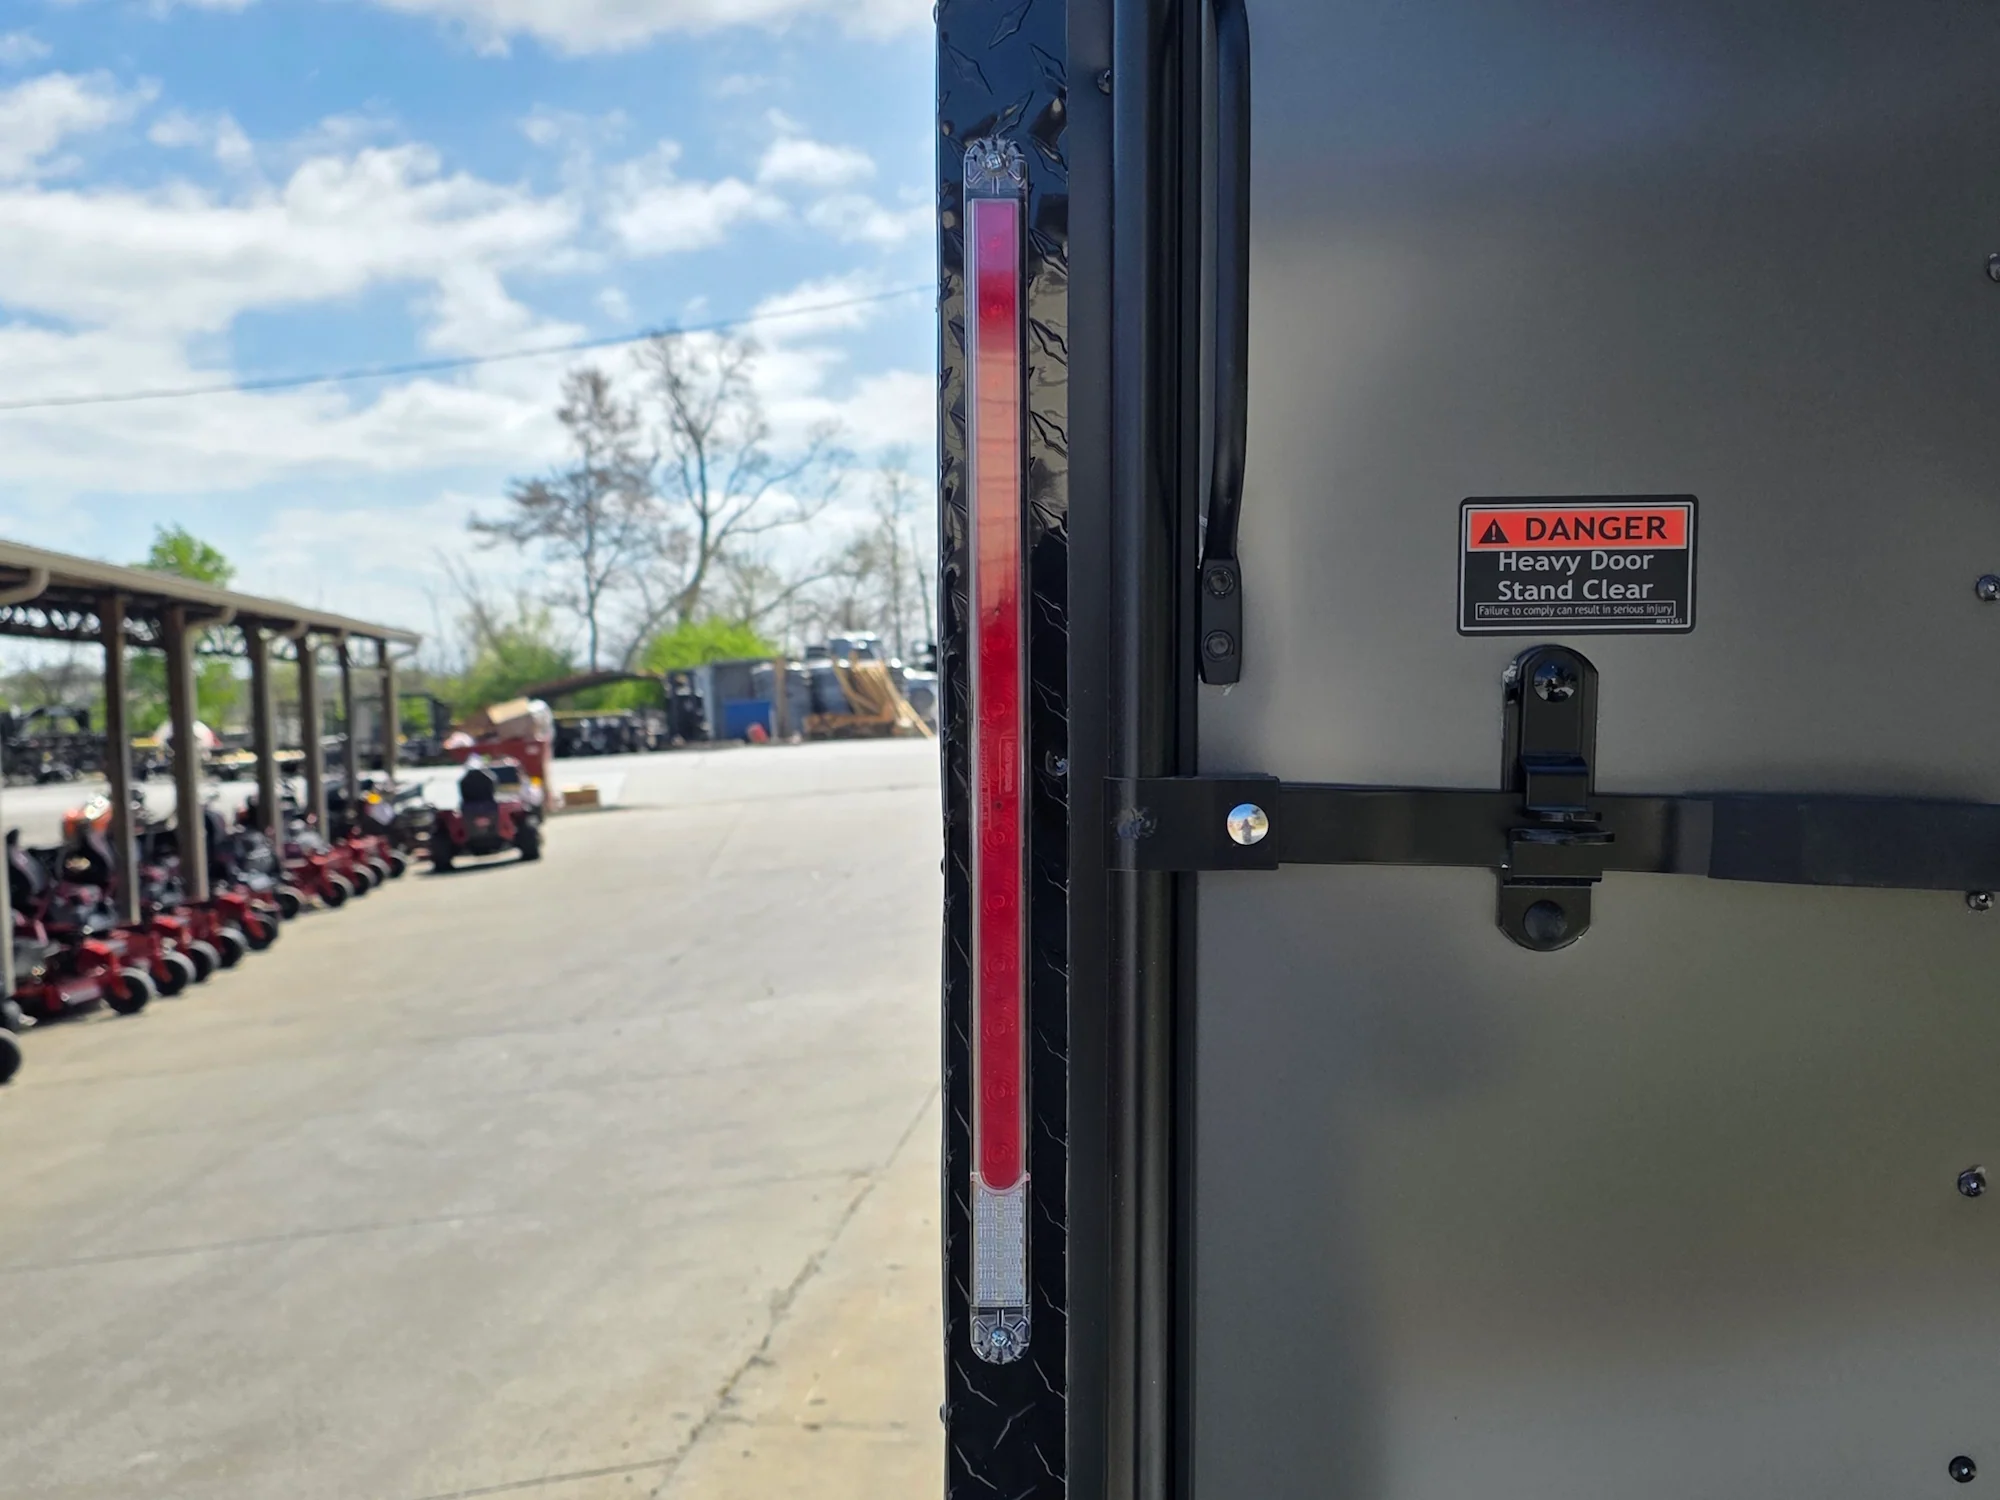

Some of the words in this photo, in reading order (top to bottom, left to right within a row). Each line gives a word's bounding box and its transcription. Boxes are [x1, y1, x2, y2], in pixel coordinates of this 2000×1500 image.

[1526, 516, 1668, 540] DANGER
[1499, 552, 1581, 575] Heavy
[1591, 551, 1654, 570] Door
[1498, 580, 1572, 601] Stand
[1582, 580, 1654, 600] Clear
[1479, 606, 1510, 615] Failure
[1512, 606, 1521, 615] to
[1523, 605, 1554, 616] comply
[1556, 606, 1572, 614] can
[1575, 604, 1600, 614] result
[1602, 604, 1610, 614] in
[1613, 604, 1644, 614] serious
[1646, 604, 1672, 616] injury
